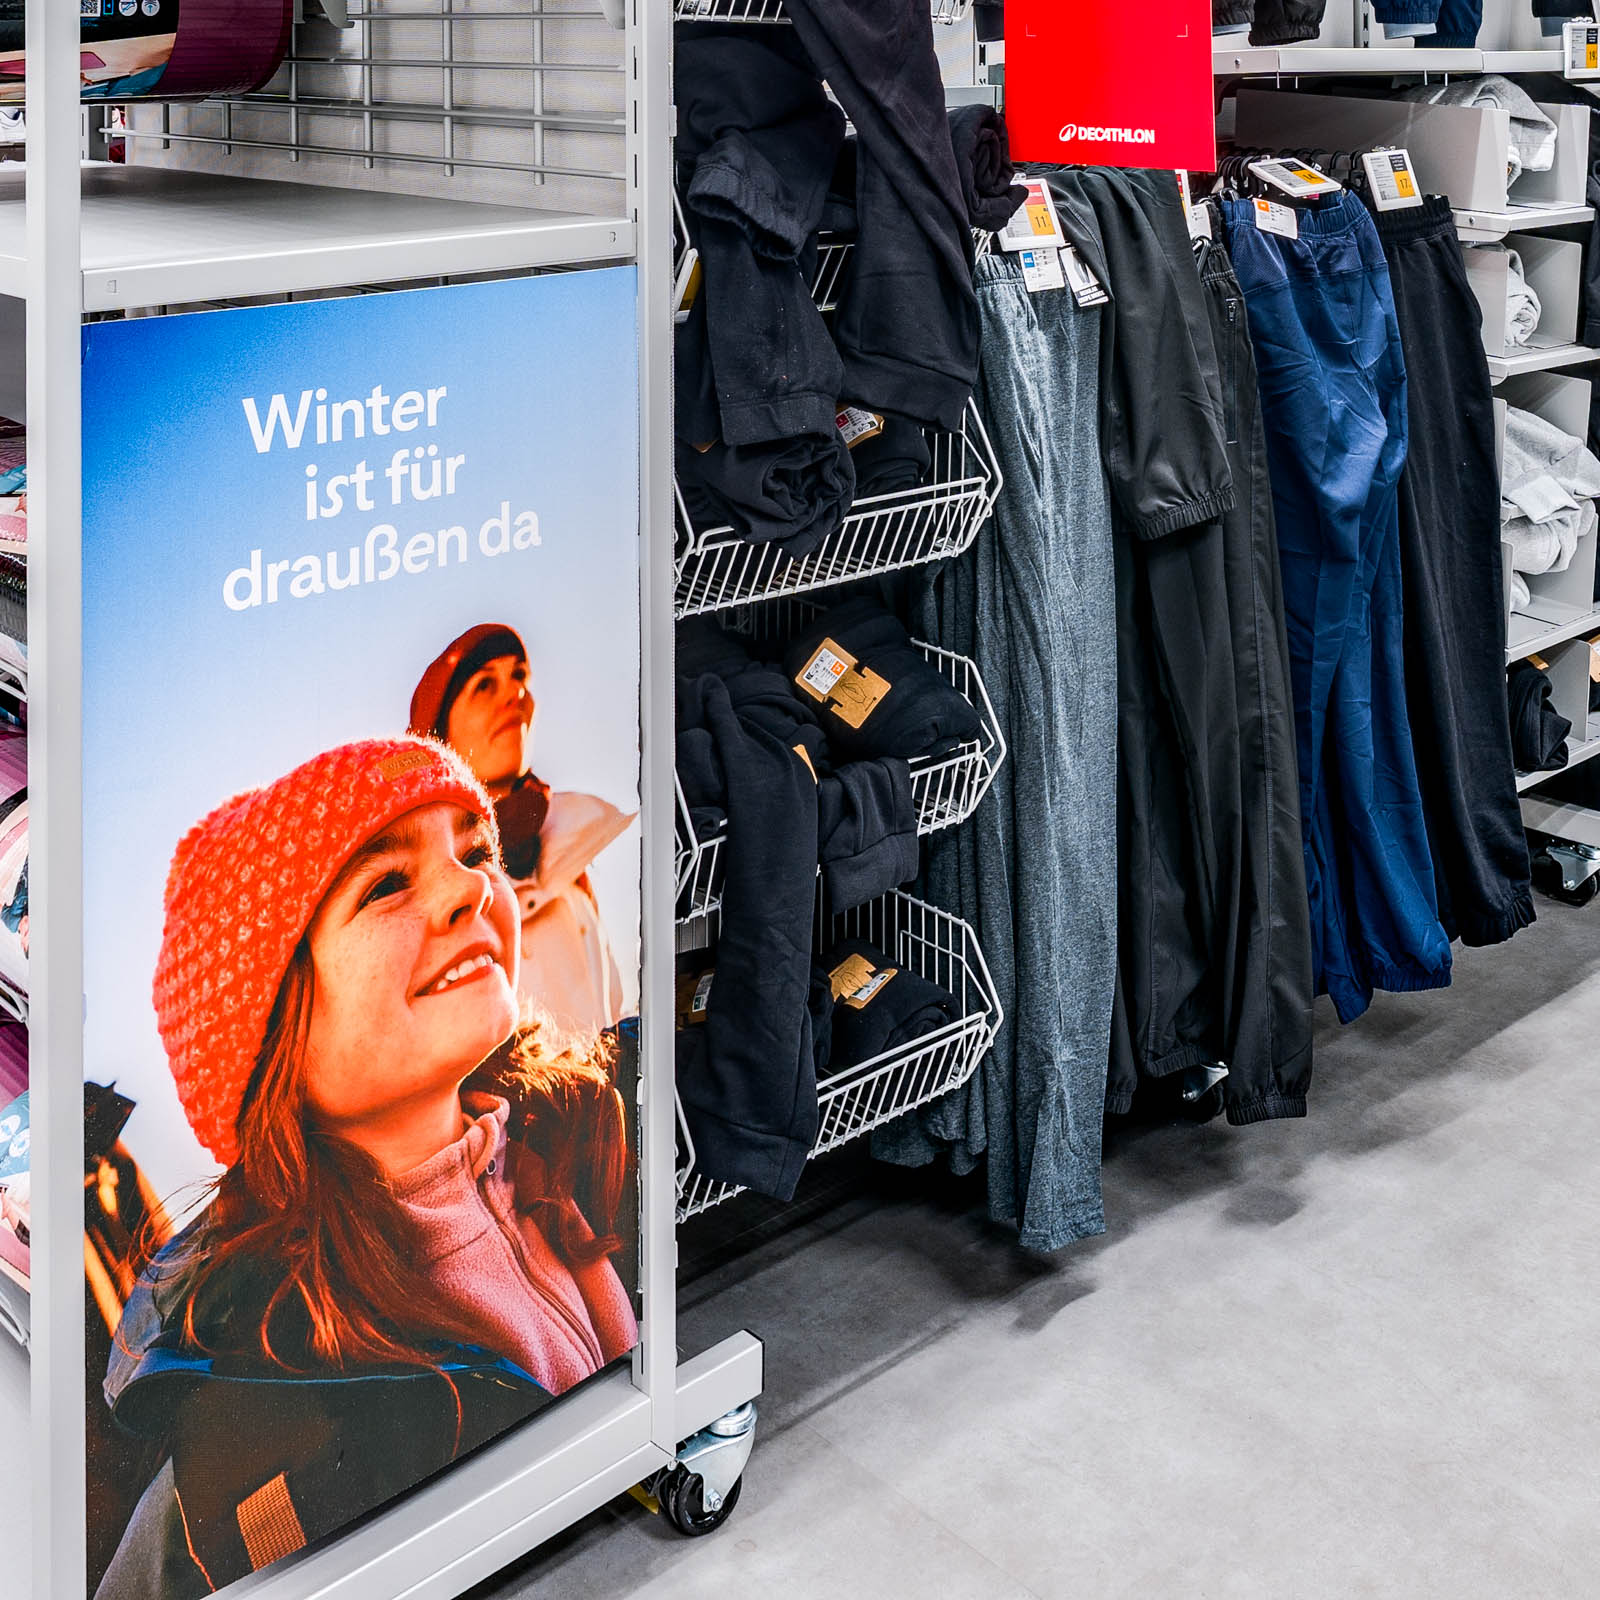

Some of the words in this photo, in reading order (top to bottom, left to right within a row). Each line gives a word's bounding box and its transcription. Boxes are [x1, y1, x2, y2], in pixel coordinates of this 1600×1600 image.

[1077, 125, 1156, 144] DECATHLON
[241, 383, 448, 455] Winter
[305, 460, 375, 521] ist
[385, 443, 466, 505] für
[222, 523, 468, 612] draußen
[478, 501, 542, 558] da
